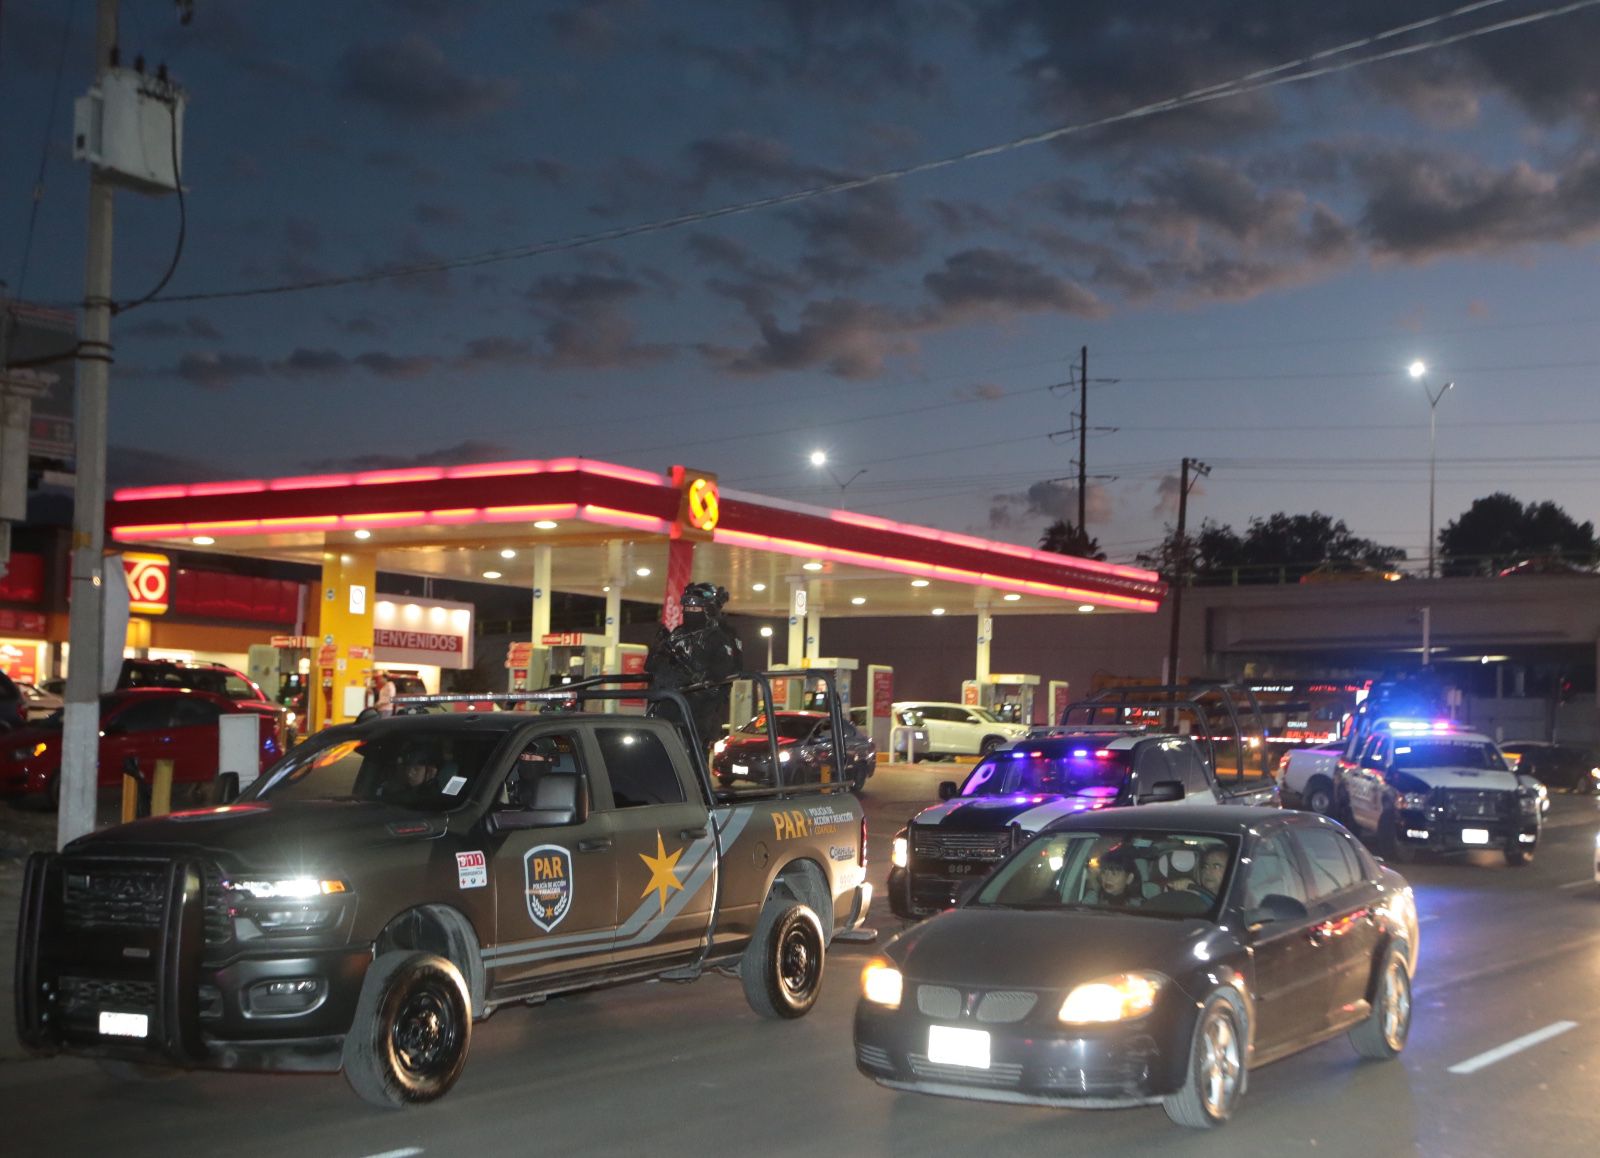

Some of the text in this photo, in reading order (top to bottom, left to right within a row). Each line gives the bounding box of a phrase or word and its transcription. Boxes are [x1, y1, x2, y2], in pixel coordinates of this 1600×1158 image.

[124, 561, 167, 601] XO
[375, 631, 457, 650] IENVENIDOS
[771, 810, 808, 840] PAR
[459, 854, 482, 867] 911
[533, 856, 563, 880] PAR
